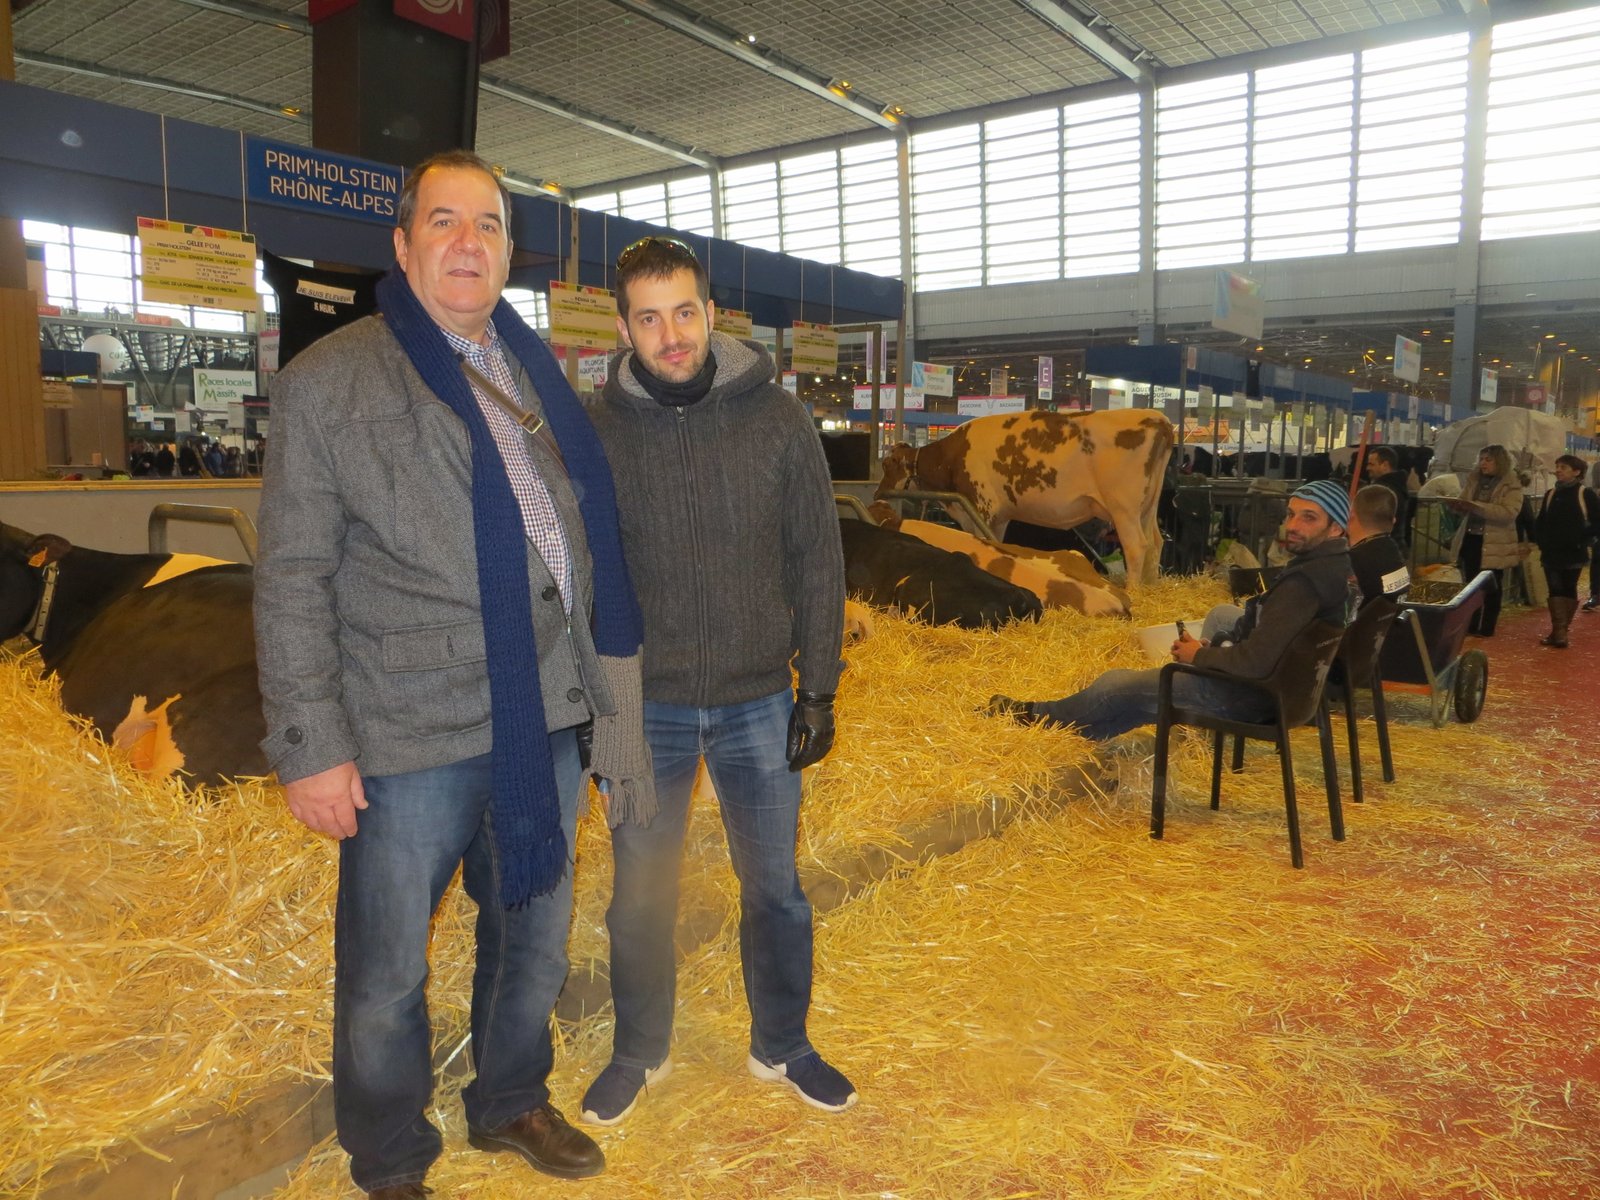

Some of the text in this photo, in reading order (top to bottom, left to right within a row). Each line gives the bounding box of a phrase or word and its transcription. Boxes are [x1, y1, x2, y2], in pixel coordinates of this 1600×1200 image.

[265, 150, 396, 194] PRIM'HOLSTEIN
[270, 176, 394, 216] RHÔNE-ALPES
[205, 242, 220, 250] POM
[198, 372, 253, 387] Races locales
[1042, 367, 1049, 382] E
[203, 388, 237, 402] Massifs
